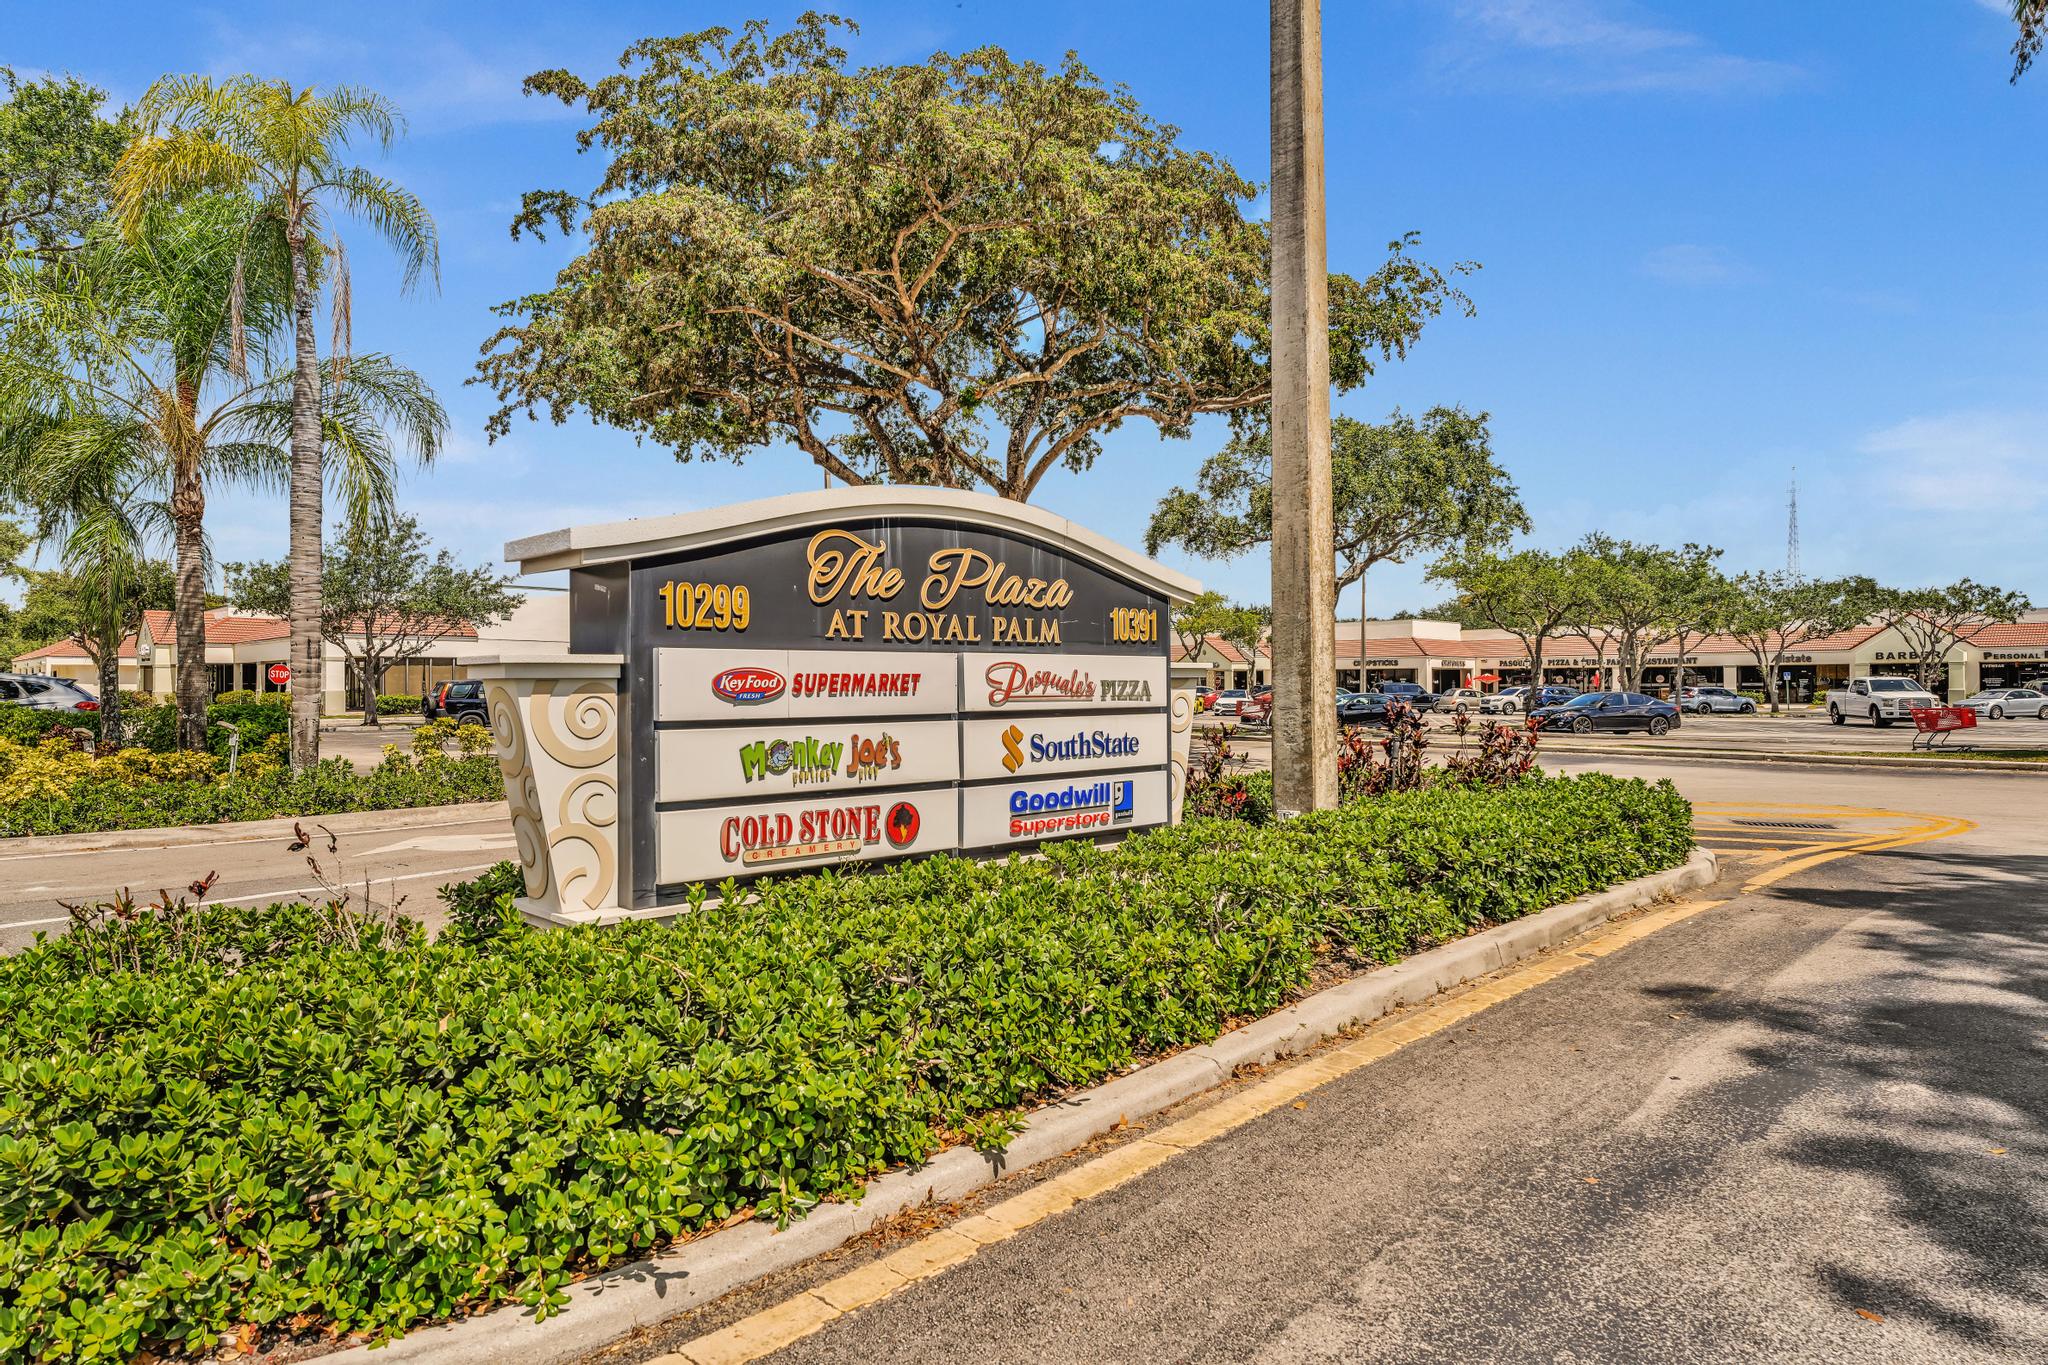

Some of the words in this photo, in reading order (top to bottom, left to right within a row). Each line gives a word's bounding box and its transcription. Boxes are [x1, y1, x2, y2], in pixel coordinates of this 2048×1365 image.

[807, 529, 905, 604] The
[920, 547, 1074, 610] Plaza
[658, 580, 751, 629] 10299
[825, 608, 869, 639] AT
[882, 611, 981, 641] ROYAL
[992, 616, 1062, 644] PALM
[1109, 607, 1158, 643] 10391
[269, 670, 290, 679] STOP
[791, 673, 922, 696] SUPERMARKET
[985, 661, 1096, 706] Pasquale's
[1100, 680, 1152, 699] PIZZA
[1030, 731, 1140, 762] SouthState
[1010, 783, 1110, 812] Goodwill
[720, 812, 794, 859] COLD
[799, 805, 881, 845] STONE
[1010, 812, 1111, 835] Superstore
[751, 841, 857, 860] CREAMERY
